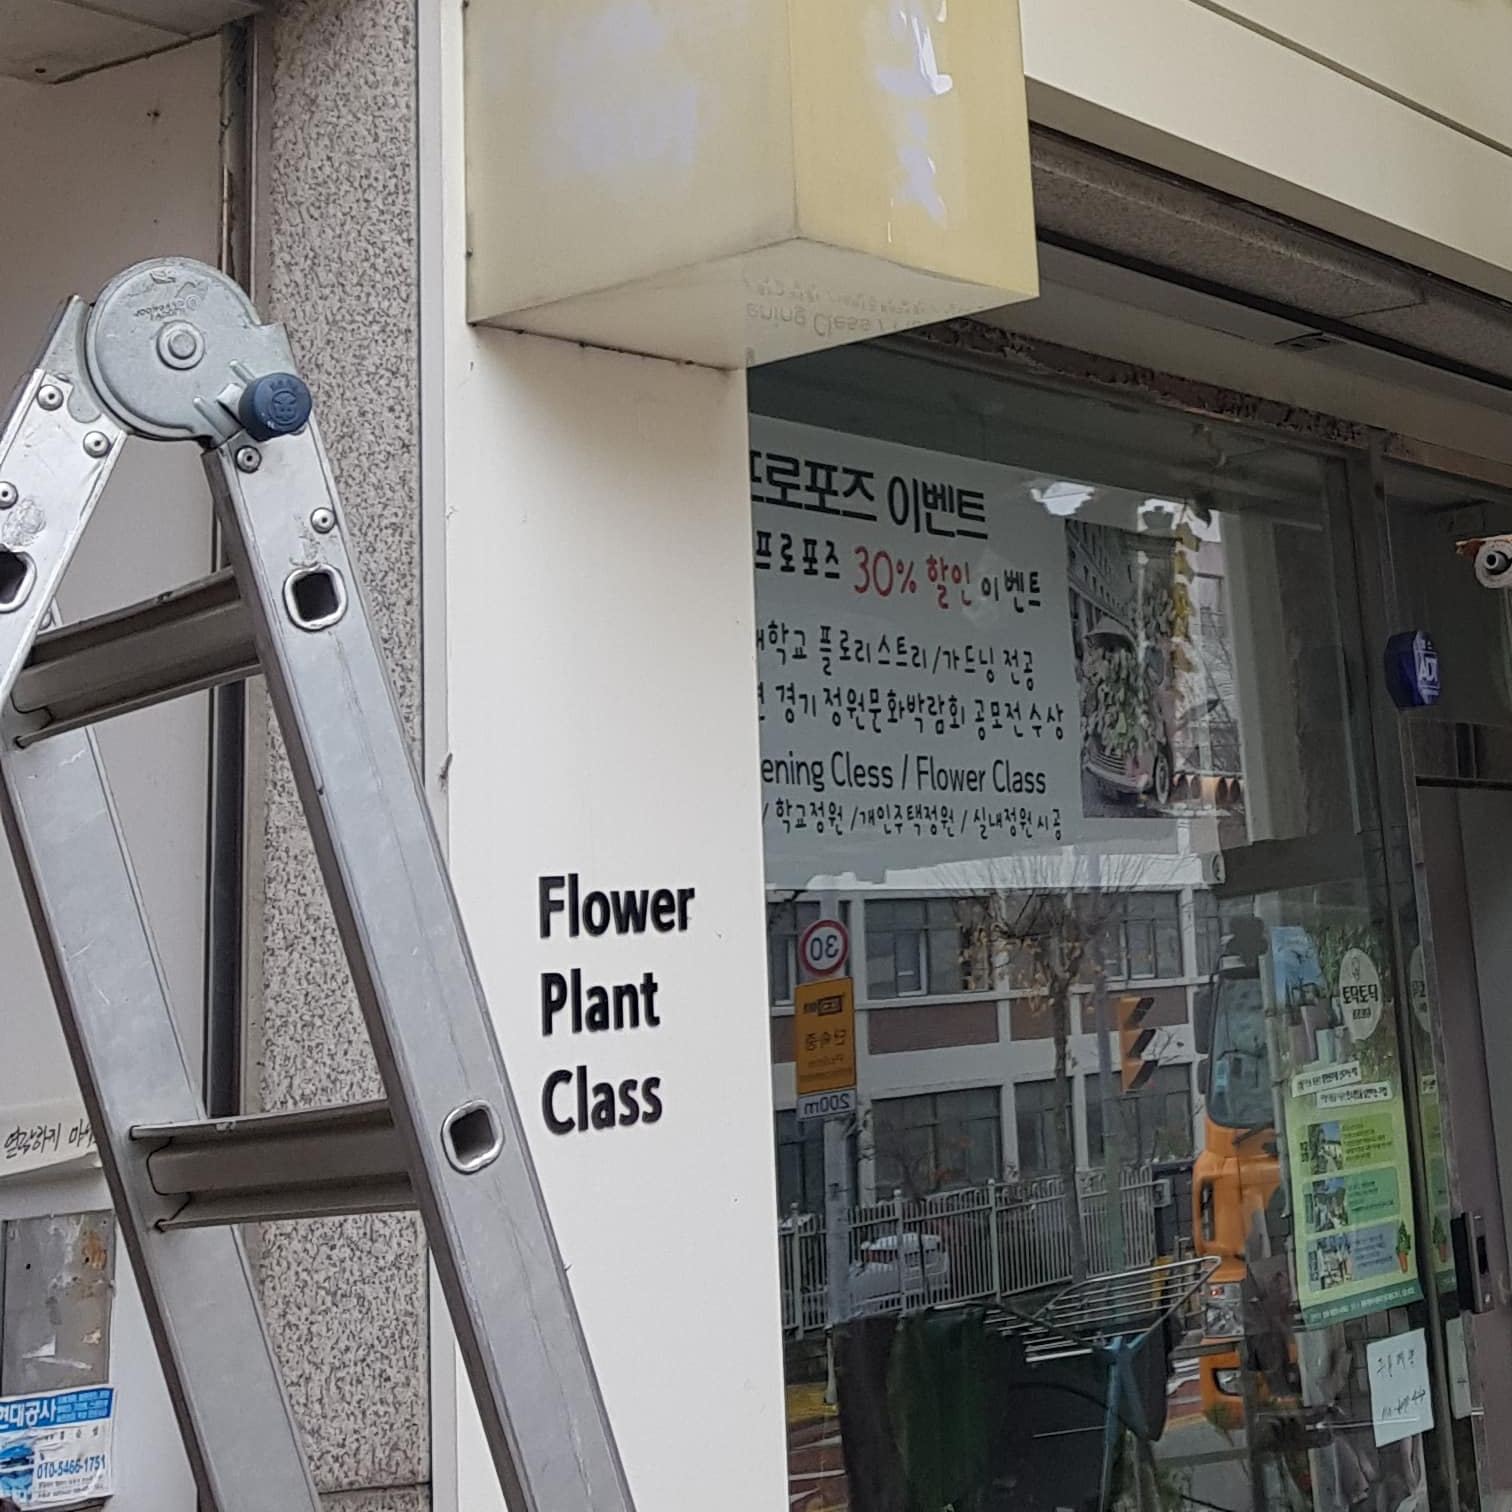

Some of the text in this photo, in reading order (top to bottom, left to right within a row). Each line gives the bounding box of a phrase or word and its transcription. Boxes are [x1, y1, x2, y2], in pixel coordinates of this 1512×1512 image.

[888, 475, 988, 540] 이벤트
[754, 530, 1041, 613] 프로포즈 30% 할인 이벤트
[1003, 649, 1034, 692] 전공
[974, 699, 1024, 741] 공모전
[1029, 701, 1065, 741] 수상
[831, 750, 894, 790] Cless
[916, 755, 986, 793] Flower
[992, 759, 1047, 795] Class
[776, 796, 844, 837] 학교정원
[973, 806, 1033, 840] 실내정원
[1037, 808, 1063, 842] 시공
[538, 872, 695, 939] Flower
[541, 968, 660, 1036] Plant
[541, 1065, 663, 1136] Class
